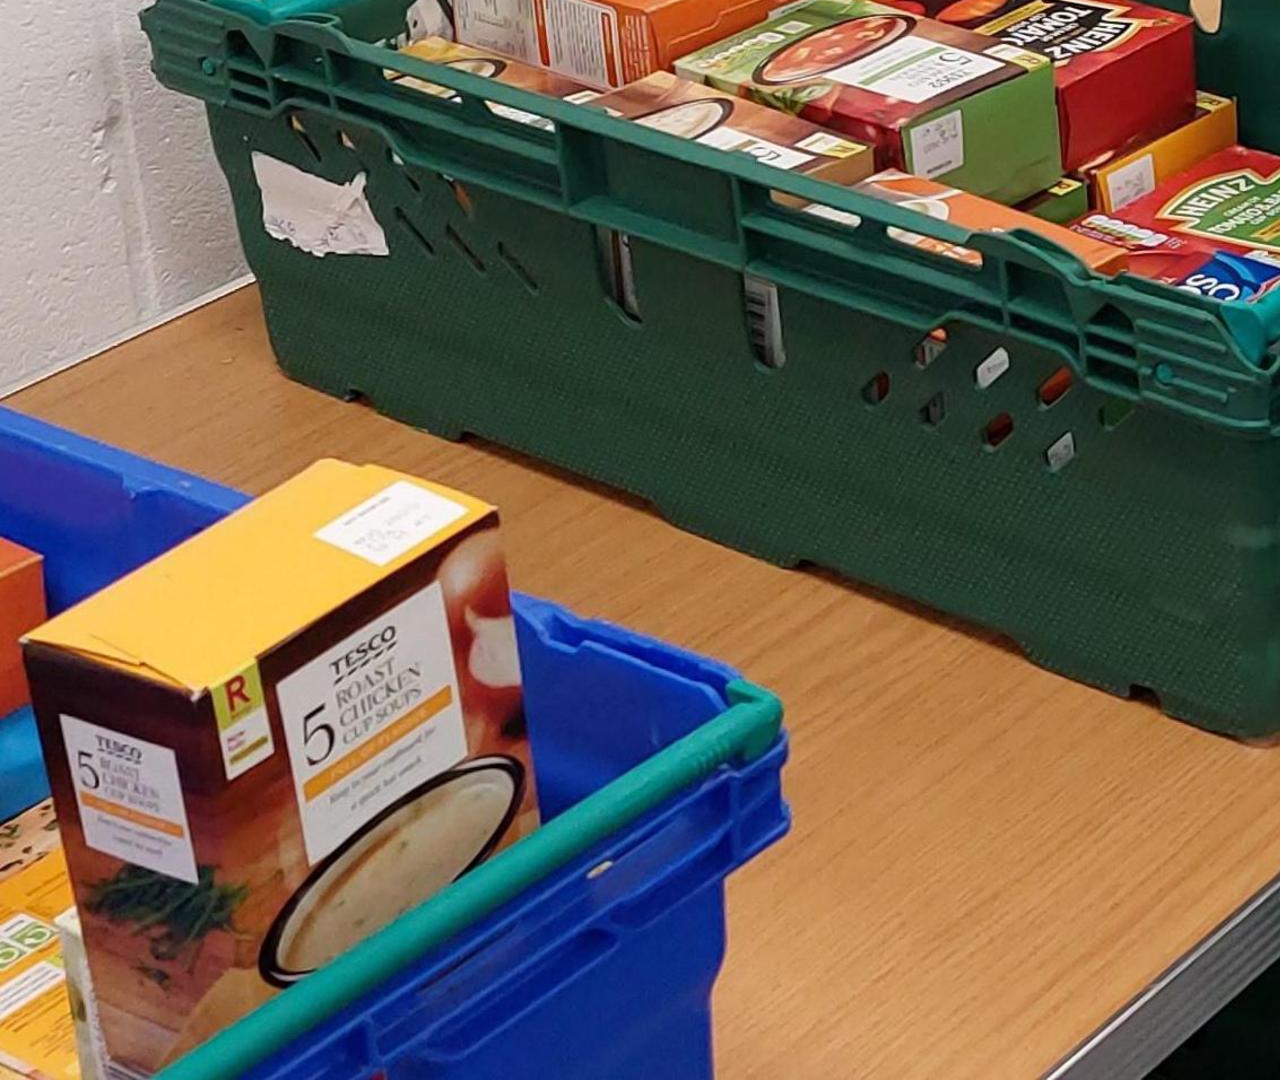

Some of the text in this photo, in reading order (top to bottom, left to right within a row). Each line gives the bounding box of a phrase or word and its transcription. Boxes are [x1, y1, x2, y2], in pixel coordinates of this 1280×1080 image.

[1045, 22, 1126, 60] HEINZ
[1174, 176, 1256, 217] HEINZ
[330, 624, 397, 677] TESCO
[225, 675, 251, 713] R
[335, 656, 397, 709] ROAST
[340, 662, 423, 727] CHICKEN
[95, 734, 143, 760] TESCO
[302, 702, 336, 767] 5
[77, 750, 100, 790] 5
